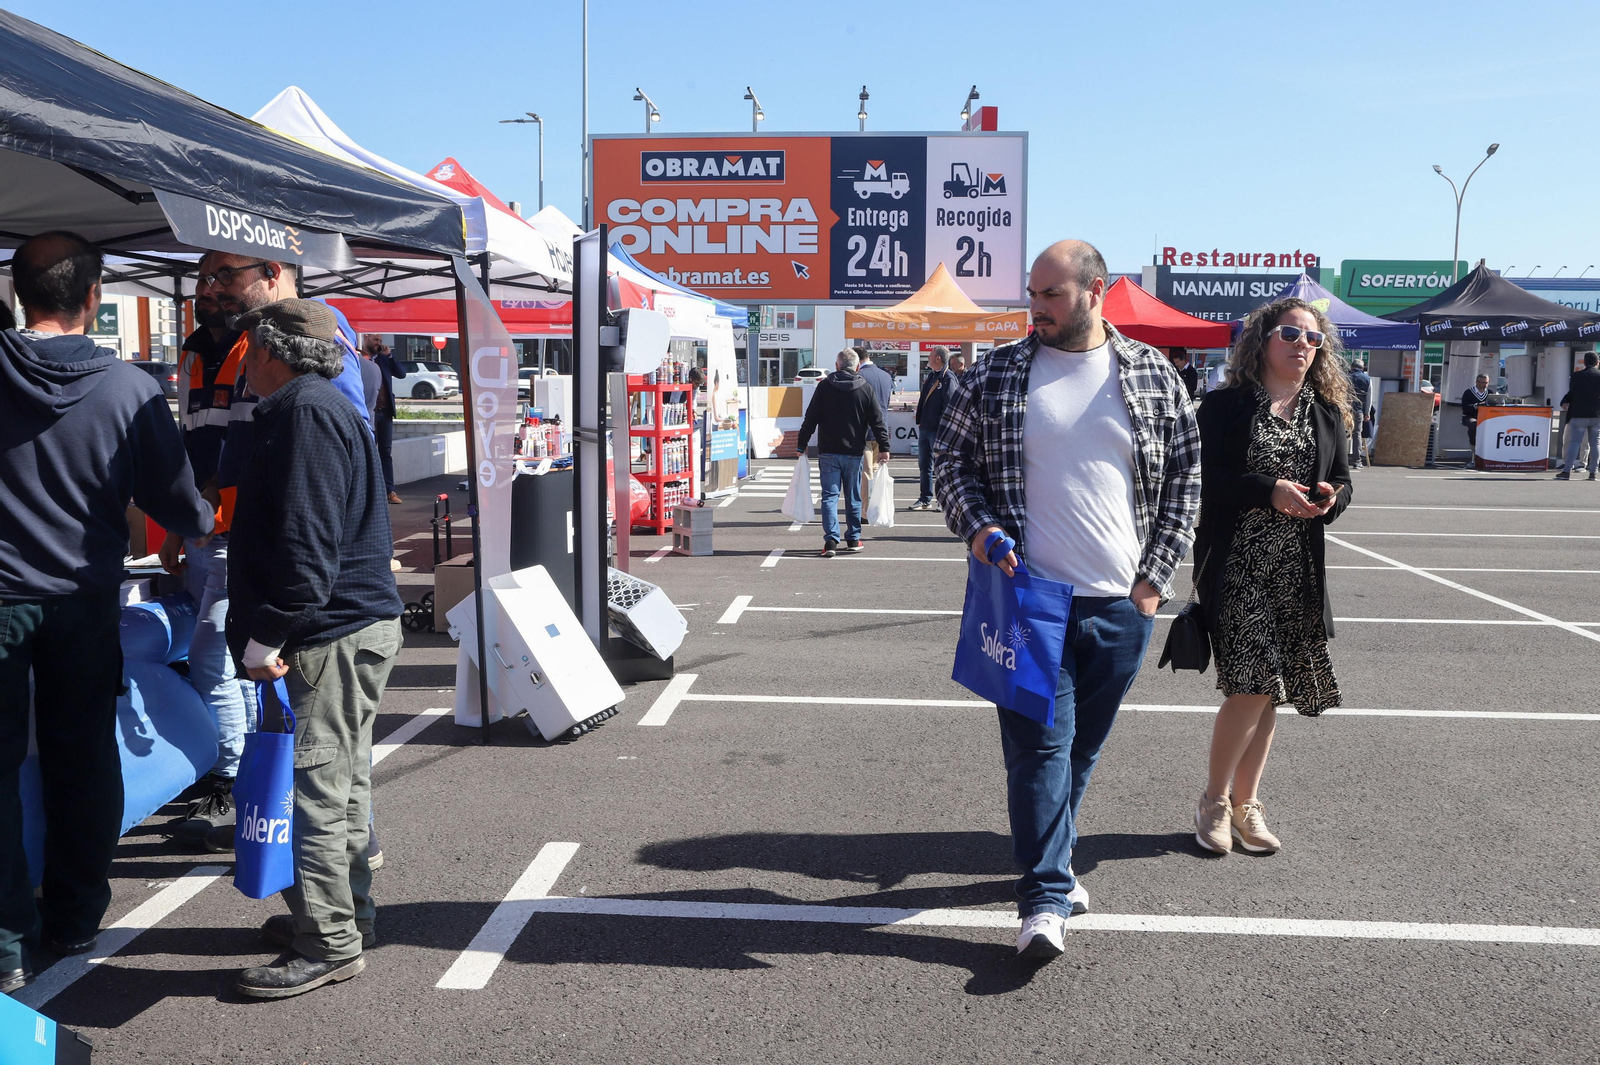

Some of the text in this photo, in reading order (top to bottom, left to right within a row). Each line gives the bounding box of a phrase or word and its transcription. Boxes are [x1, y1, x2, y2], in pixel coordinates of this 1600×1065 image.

[645, 157, 781, 177] OBRAMAT
[607, 198, 819, 224] COMPRA
[848, 207, 909, 233] Entrega
[936, 206, 1012, 233] Recogida
[205, 204, 287, 250] DSPSolar
[607, 224, 819, 254] ONLINE
[847, 234, 909, 277] 24h
[955, 235, 992, 278] 2h
[1162, 247, 1316, 268] Restaurante
[1173, 280, 1289, 298] NANAMI SUS
[1360, 270, 1452, 288] SOFERTÓN
[986, 321, 1019, 332] CAPA
[1337, 329, 1357, 337] TIK
[1425, 320, 1452, 336] Ferroli
[1463, 321, 1490, 336] Ferroli
[1501, 320, 1528, 337] Ferroli
[1540, 320, 1568, 337] Ferroli
[895, 426, 919, 440] CA
[1496, 432, 1539, 449] Ferroli
[981, 622, 1017, 671] Solera
[241, 802, 290, 844] Solera
